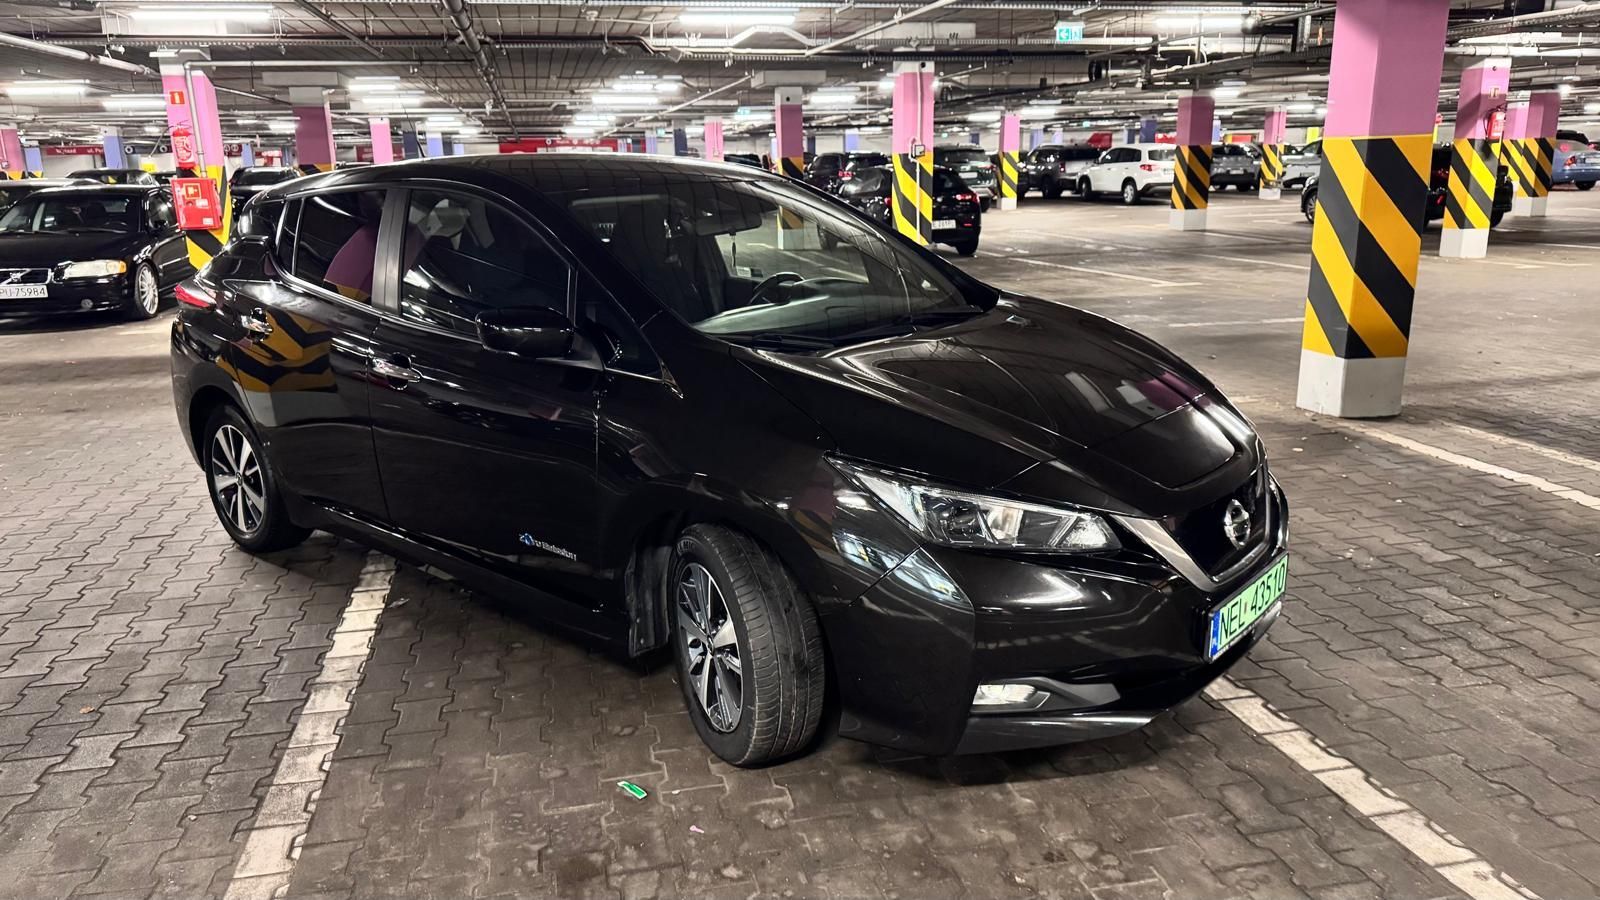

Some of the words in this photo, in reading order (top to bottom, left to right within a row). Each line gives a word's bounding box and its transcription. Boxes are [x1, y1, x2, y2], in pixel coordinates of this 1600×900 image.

[16, 287, 46, 297] 75984
[1219, 597, 1245, 645] NEL
[1250, 562, 1286, 616] 43510
